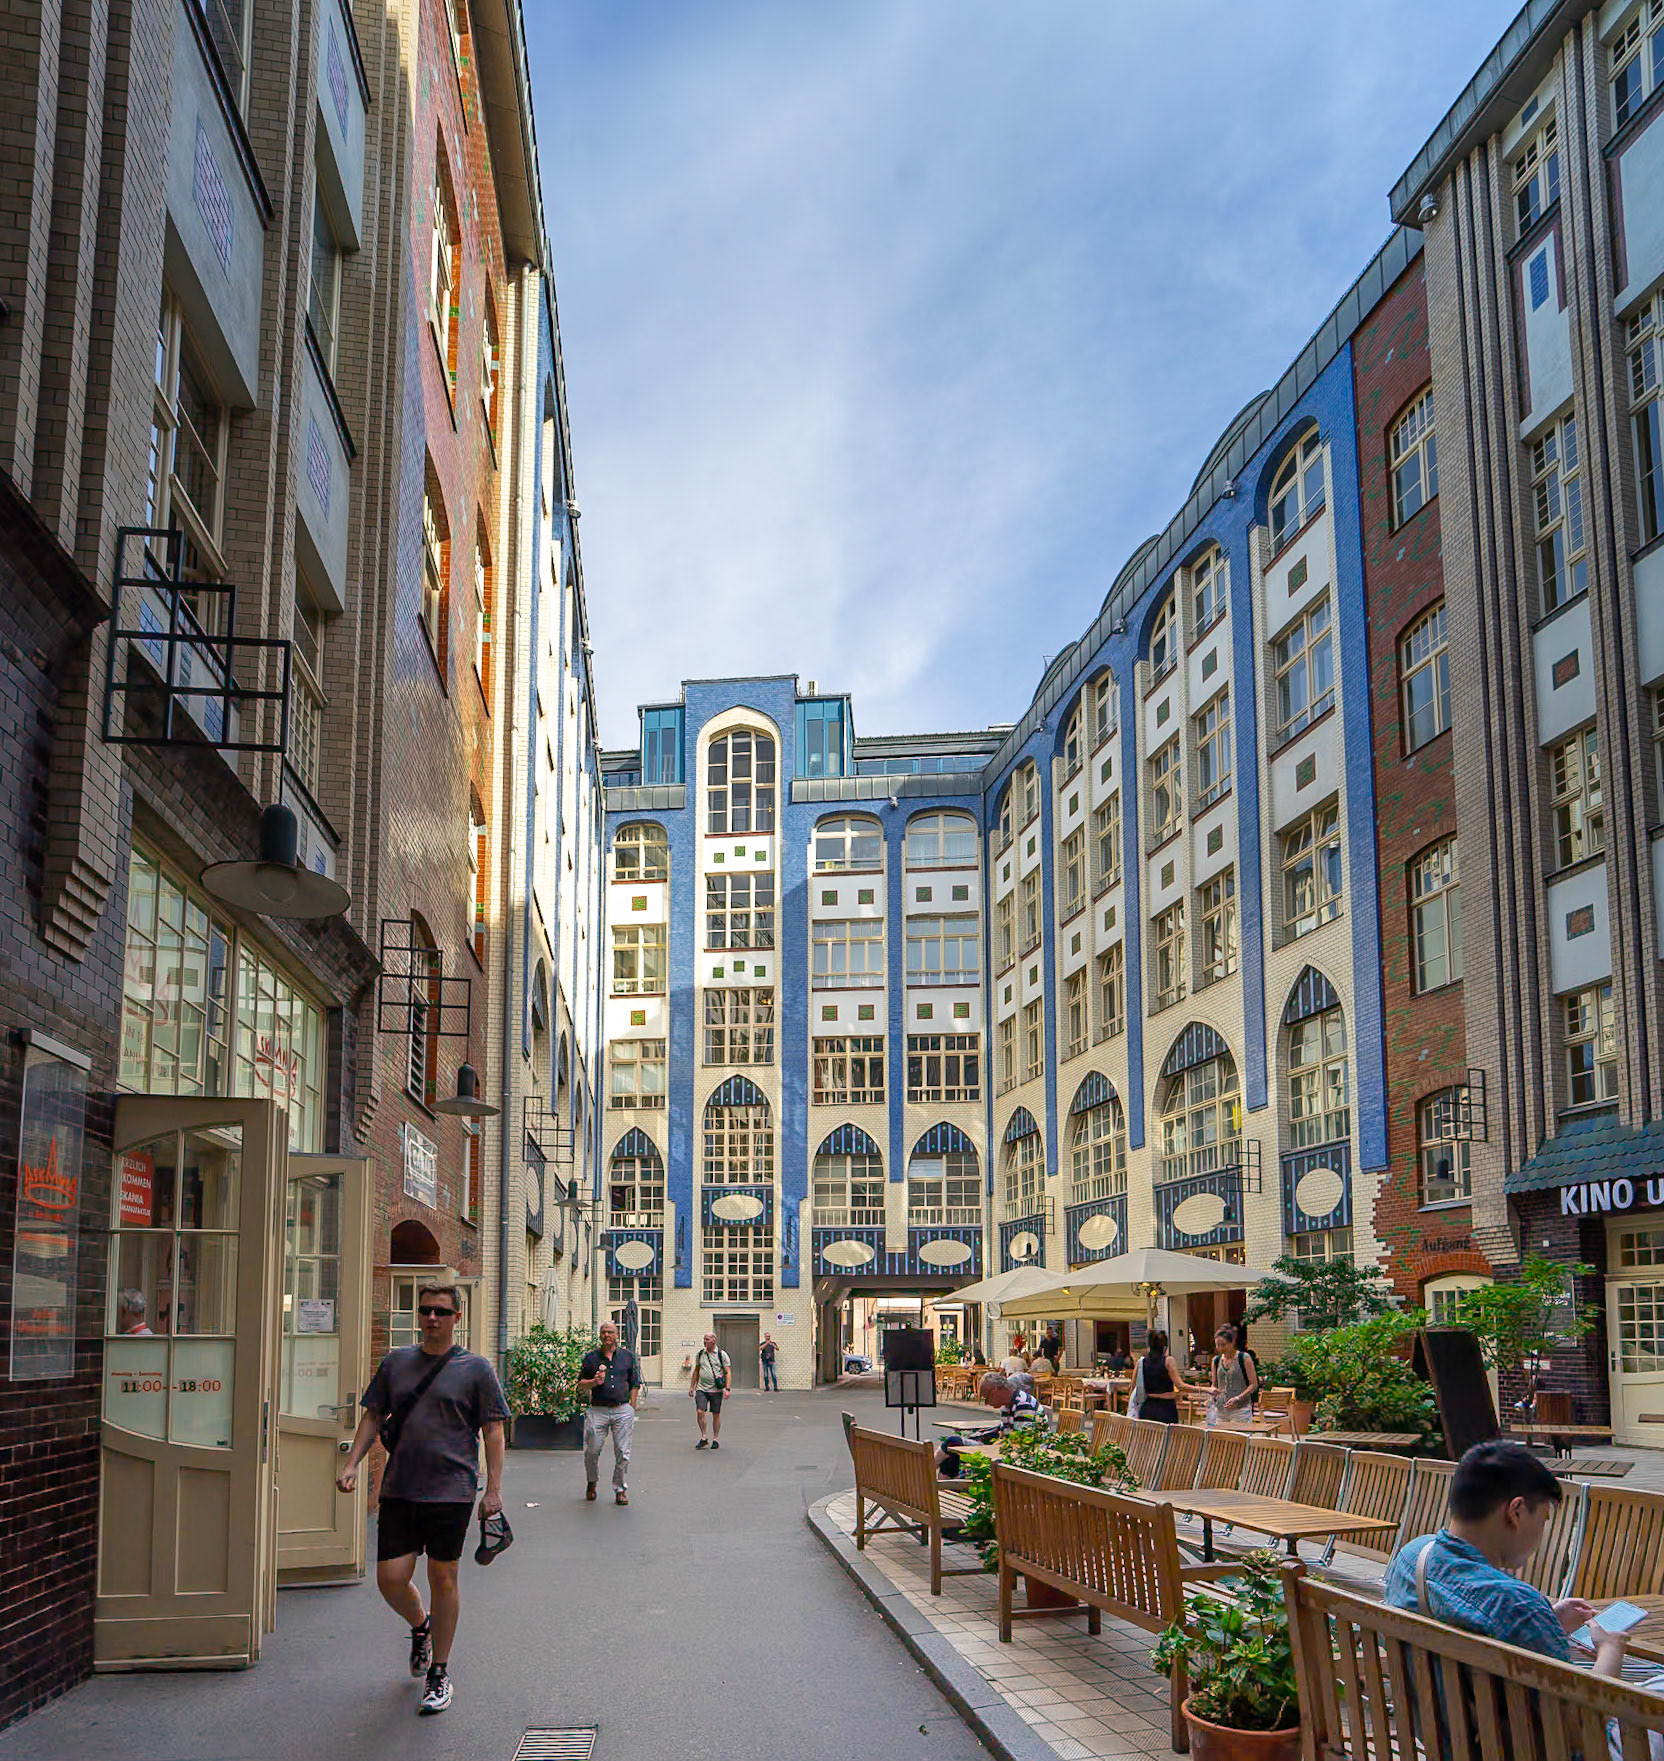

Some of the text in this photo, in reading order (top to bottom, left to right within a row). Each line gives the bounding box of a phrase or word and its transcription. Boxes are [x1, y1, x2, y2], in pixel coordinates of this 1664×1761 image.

[119, 1156, 147, 1173] ERZLICH
[120, 1173, 152, 1190] KOMMEN
[119, 1190, 144, 1205] SKANIA
[1561, 1179, 1633, 1215] KINO
[122, 1379, 162, 1393] 11:00
[180, 1379, 222, 1393] 18:00
